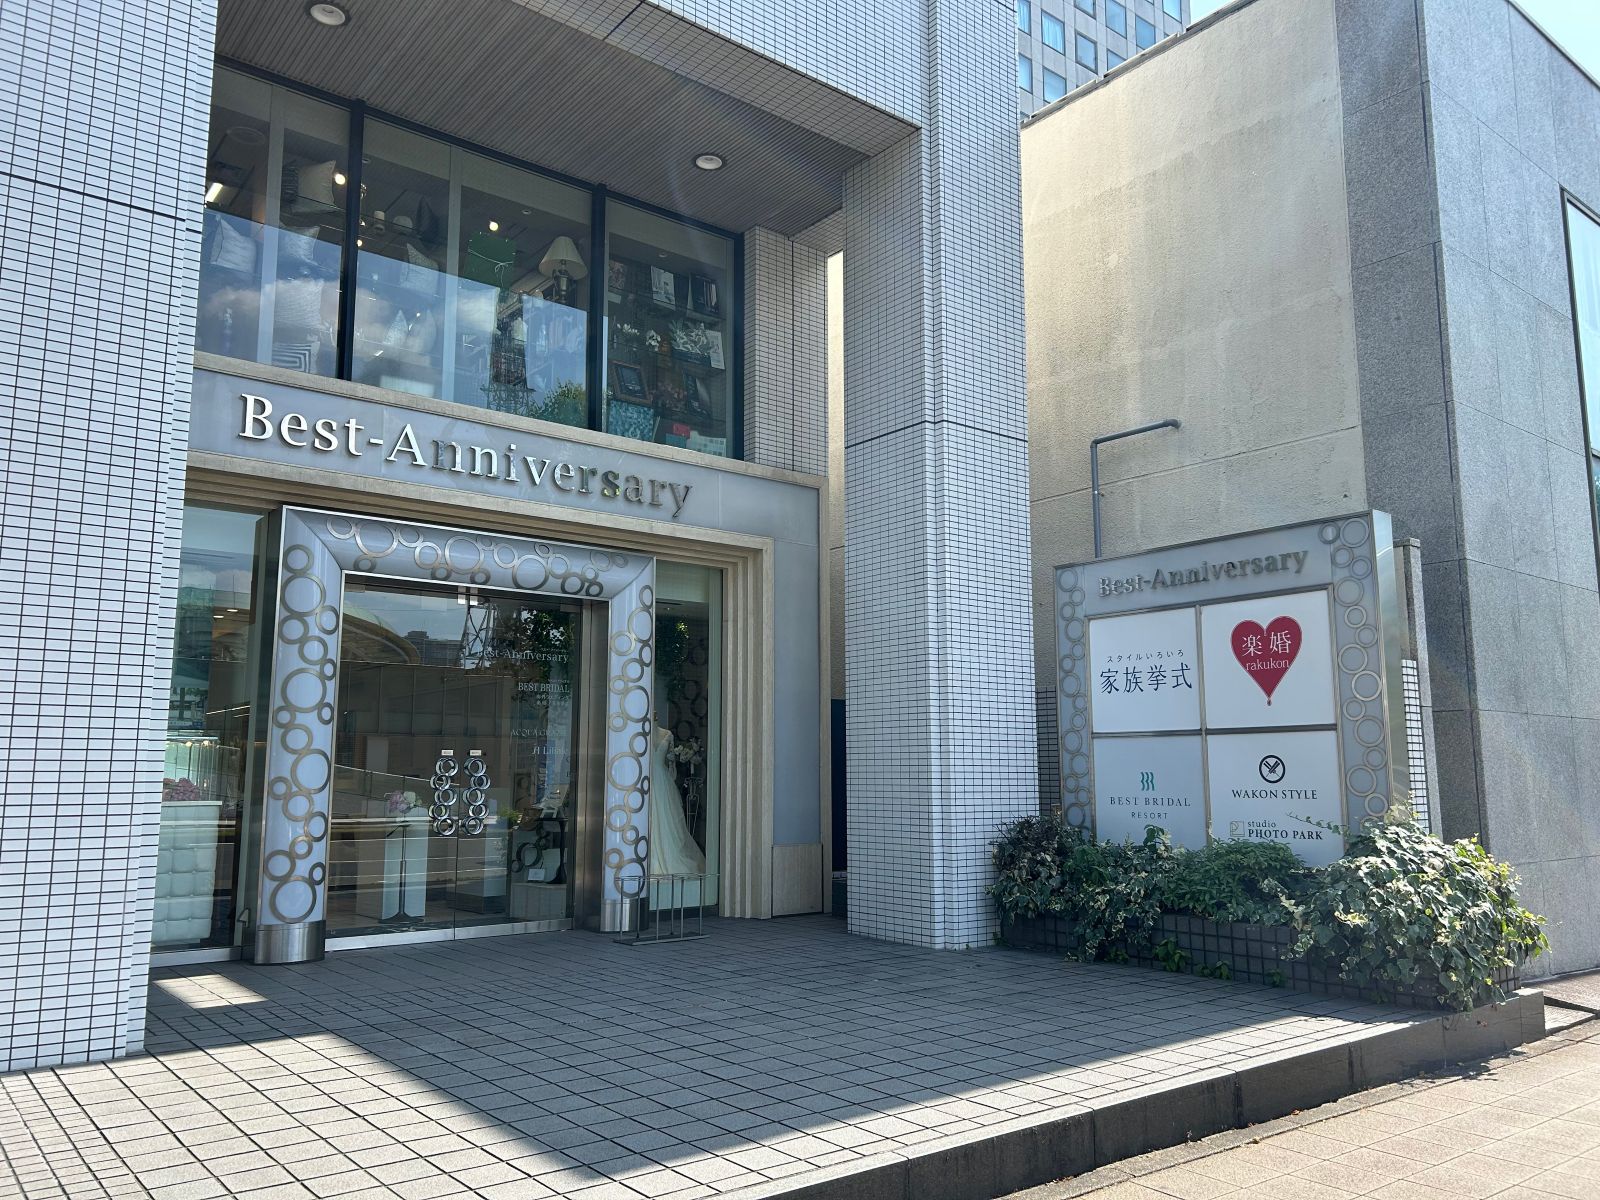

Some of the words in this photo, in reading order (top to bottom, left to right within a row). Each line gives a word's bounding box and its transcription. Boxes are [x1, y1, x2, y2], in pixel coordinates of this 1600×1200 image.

[239, 393, 693, 518] Best-Anniversary
[1099, 550, 1309, 598] Best-Anniversary
[1241, 630, 1293, 657] 楽婚
[1106, 649, 1184, 664] スタイルいろいろ
[1246, 657, 1289, 672] rakukon
[1099, 662, 1193, 695] 家族挙式
[518, 682, 538, 692] BEST
[540, 683, 570, 693] BRIDAL
[1232, 789, 1278, 800] WAKON
[1281, 789, 1318, 800] STYLE
[1110, 796, 1139, 806] BEST
[1144, 797, 1191, 807] BRIDAL
[1131, 811, 1168, 820] RESORT
[1247, 820, 1277, 828] studio
[1248, 829, 1288, 839] PHOTO
[1292, 831, 1323, 840] PARK
